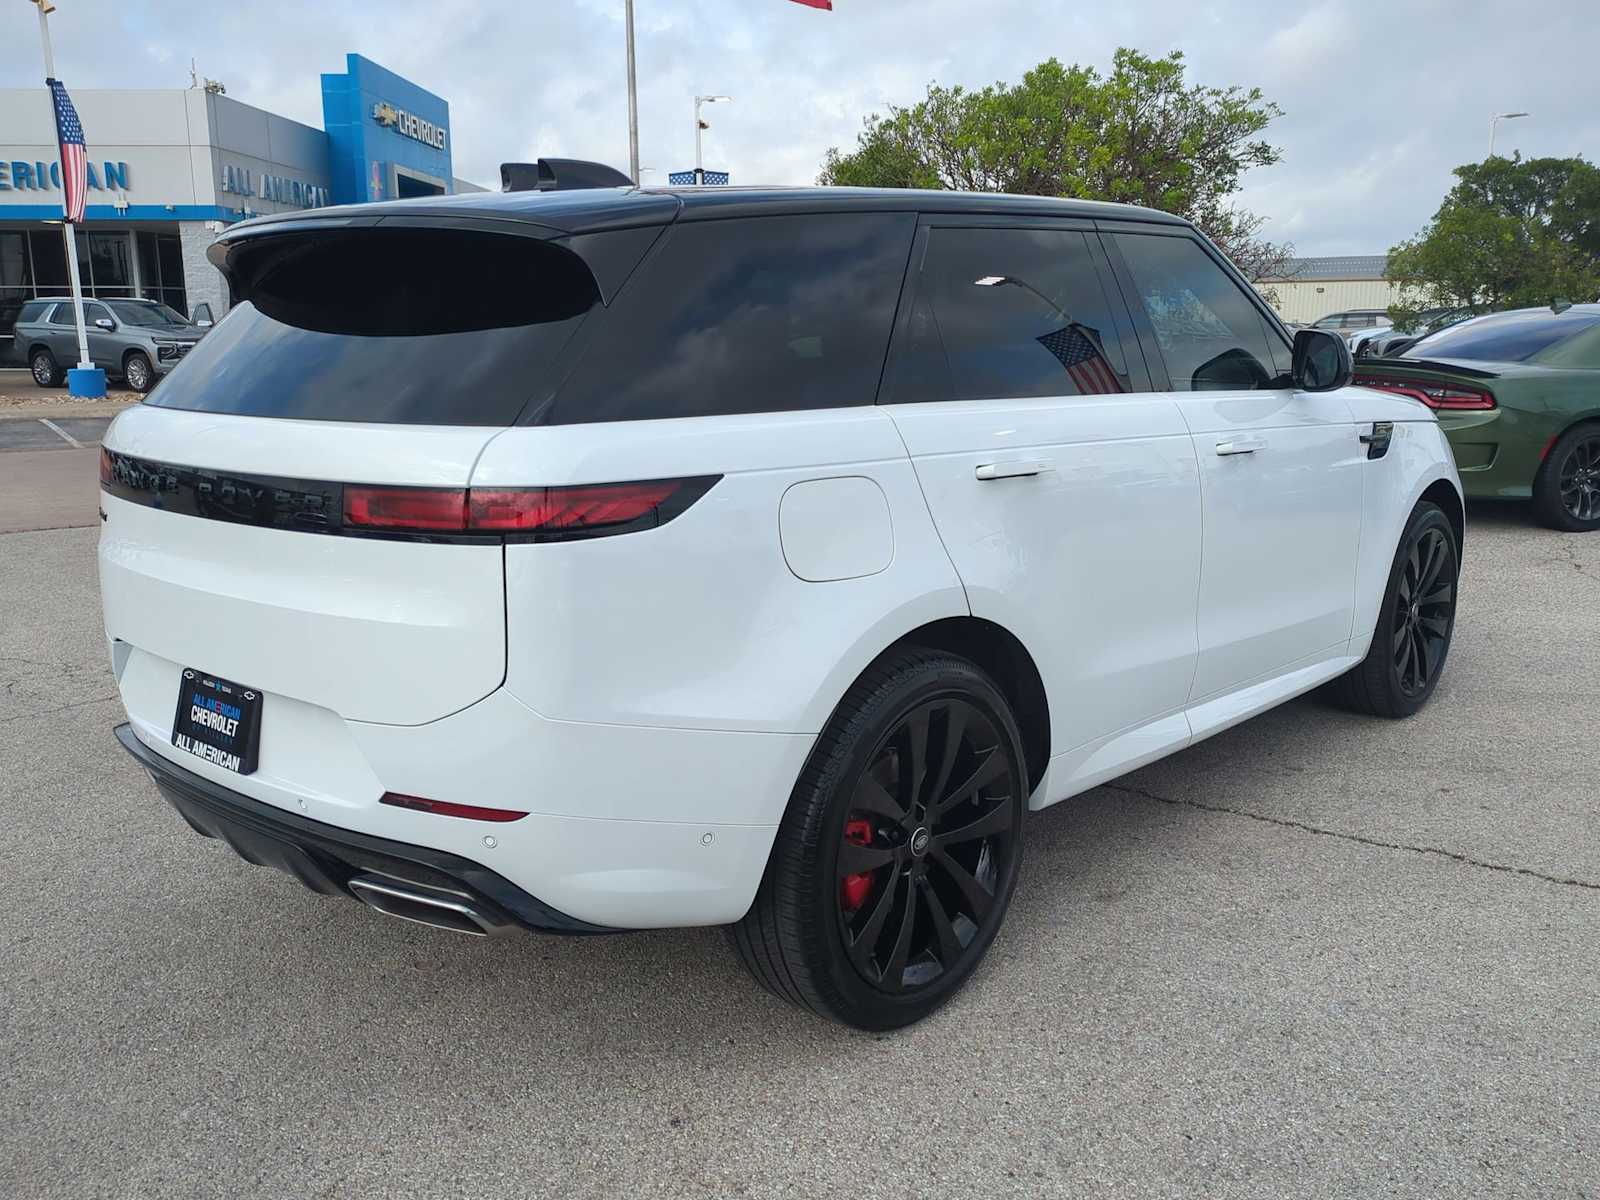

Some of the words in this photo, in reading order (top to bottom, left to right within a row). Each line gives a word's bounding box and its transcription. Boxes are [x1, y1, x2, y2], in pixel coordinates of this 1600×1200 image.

[398, 109, 446, 151] CHEVROLET
[222, 165, 256, 195] ALL
[260, 174, 329, 209] AMERICAN
[191, 705, 239, 737] CHEVROLET
[193, 693, 205, 706] ALL
[206, 700, 240, 720] AMERICAN
[175, 734, 191, 752] ALL
[192, 740, 240, 772] AMERICAN
